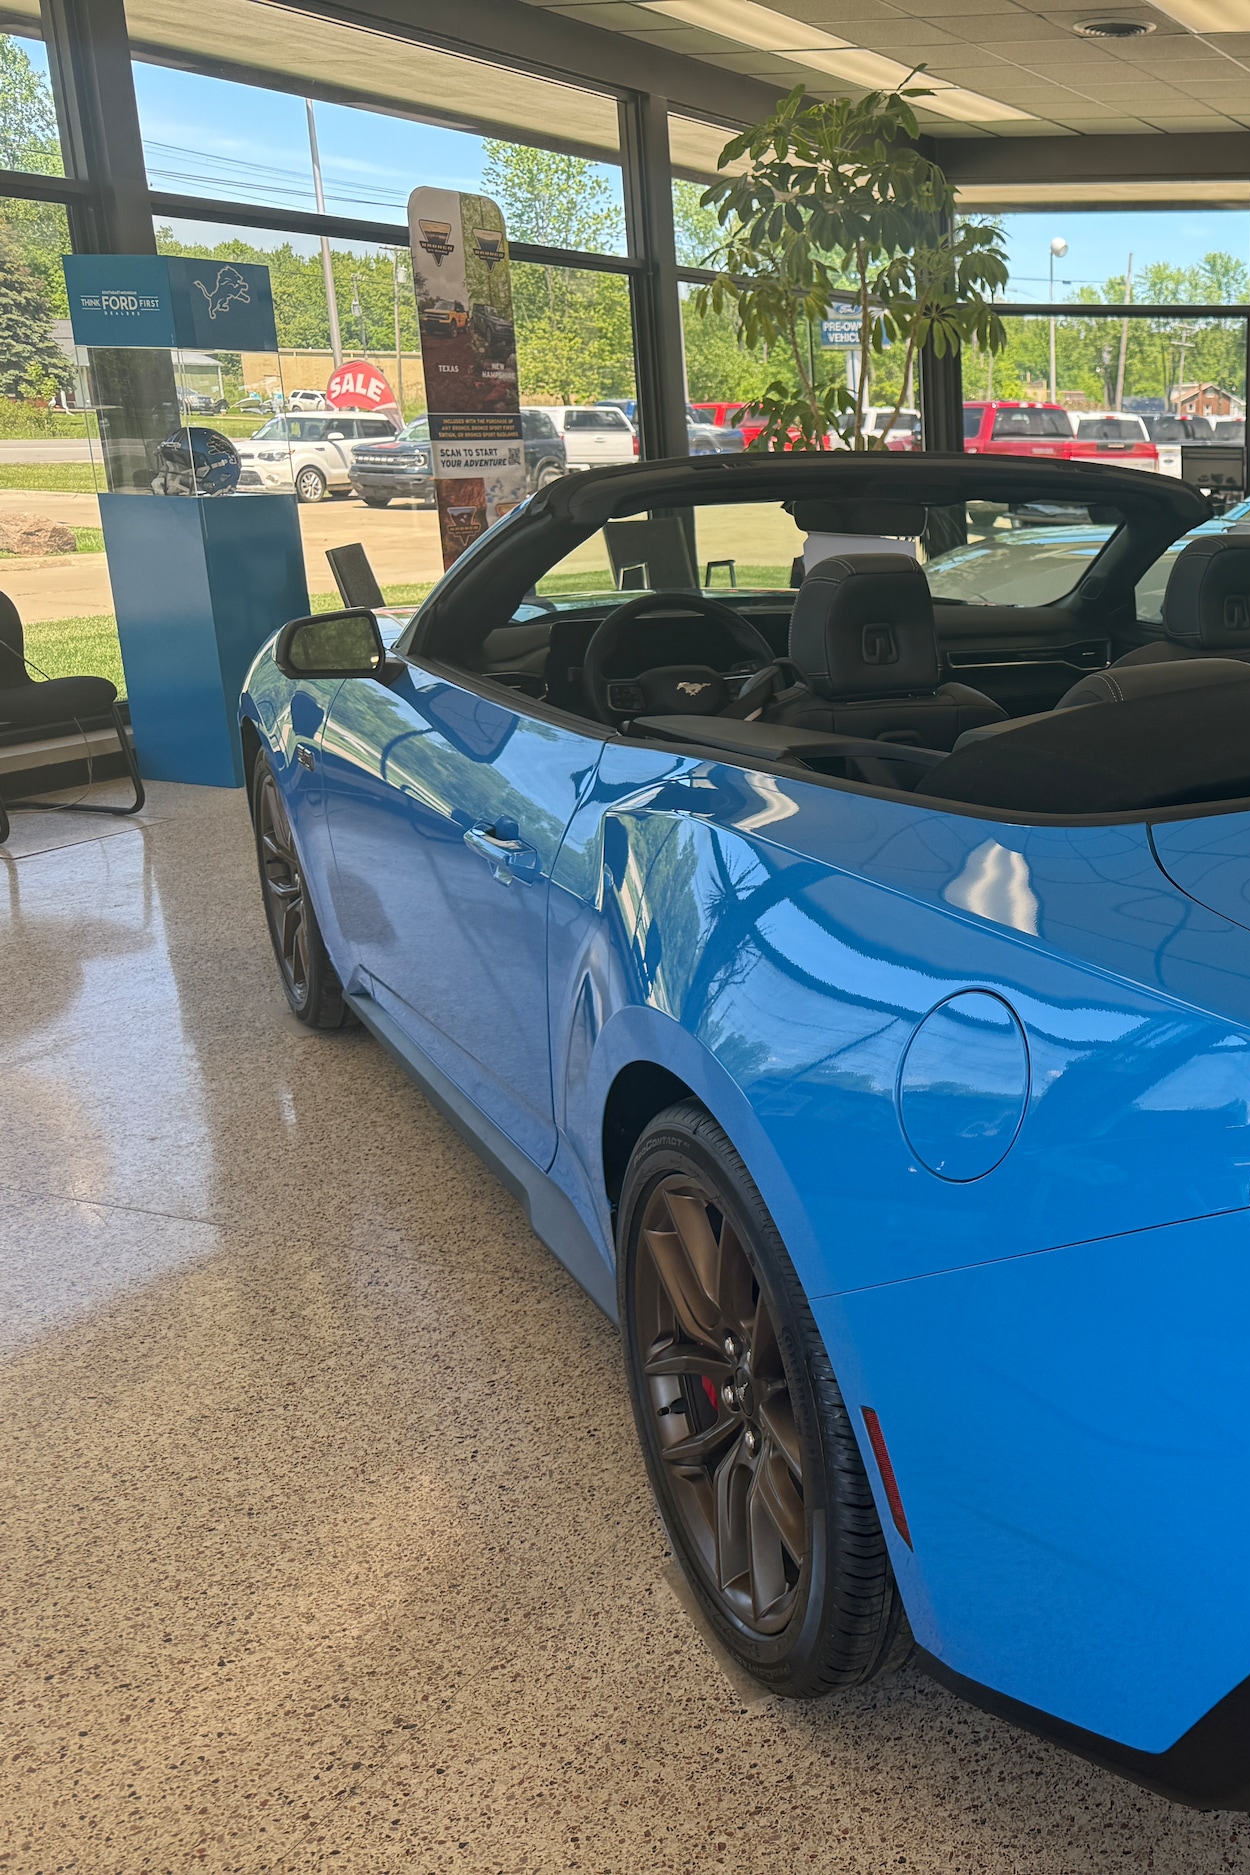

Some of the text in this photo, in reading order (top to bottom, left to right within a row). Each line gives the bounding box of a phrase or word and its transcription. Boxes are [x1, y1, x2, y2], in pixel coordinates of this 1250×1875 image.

[80, 295, 160, 310] THINK FORD FIRST
[823, 321, 863, 332] PRE-OW
[438, 365, 459, 373] TEXAS
[481, 371, 516, 379] HAMPSHIRE
[330, 373, 386, 402] SALE
[440, 449, 462, 457] SCAN
[476, 448, 498, 456] START
[441, 458, 507, 468] YOUR ADVENTURE
